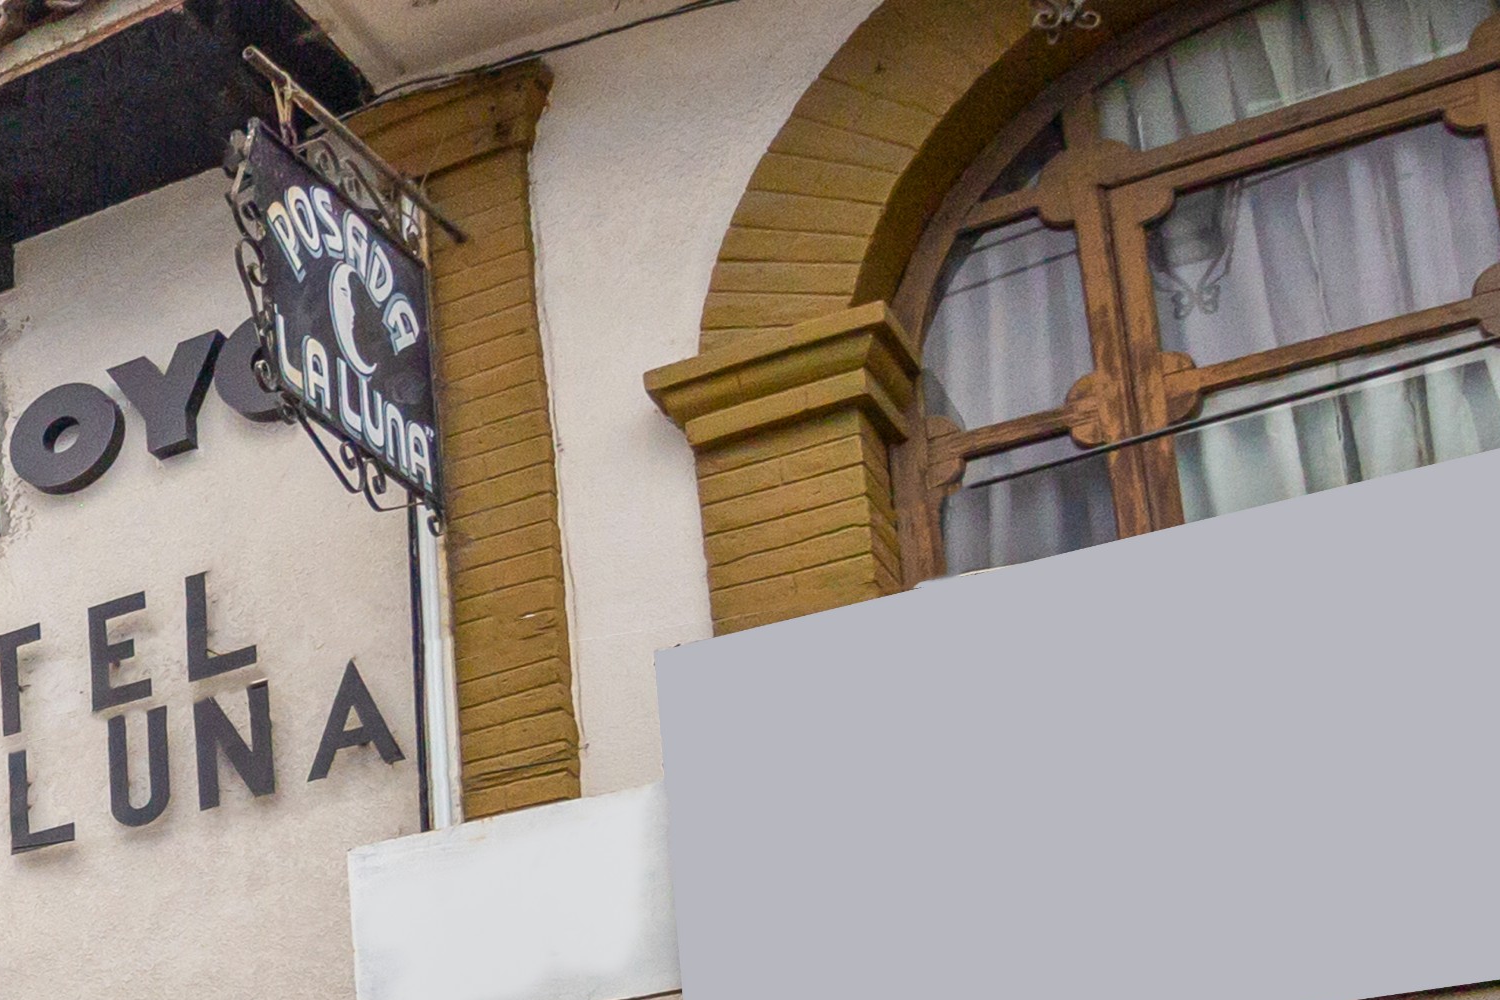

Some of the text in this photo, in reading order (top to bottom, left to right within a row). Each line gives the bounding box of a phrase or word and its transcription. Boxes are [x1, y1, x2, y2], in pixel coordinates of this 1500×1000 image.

[267, 185, 421, 356] POSADA
[274, 303, 332, 420] LA
[8, 659, 406, 855] LUNA
